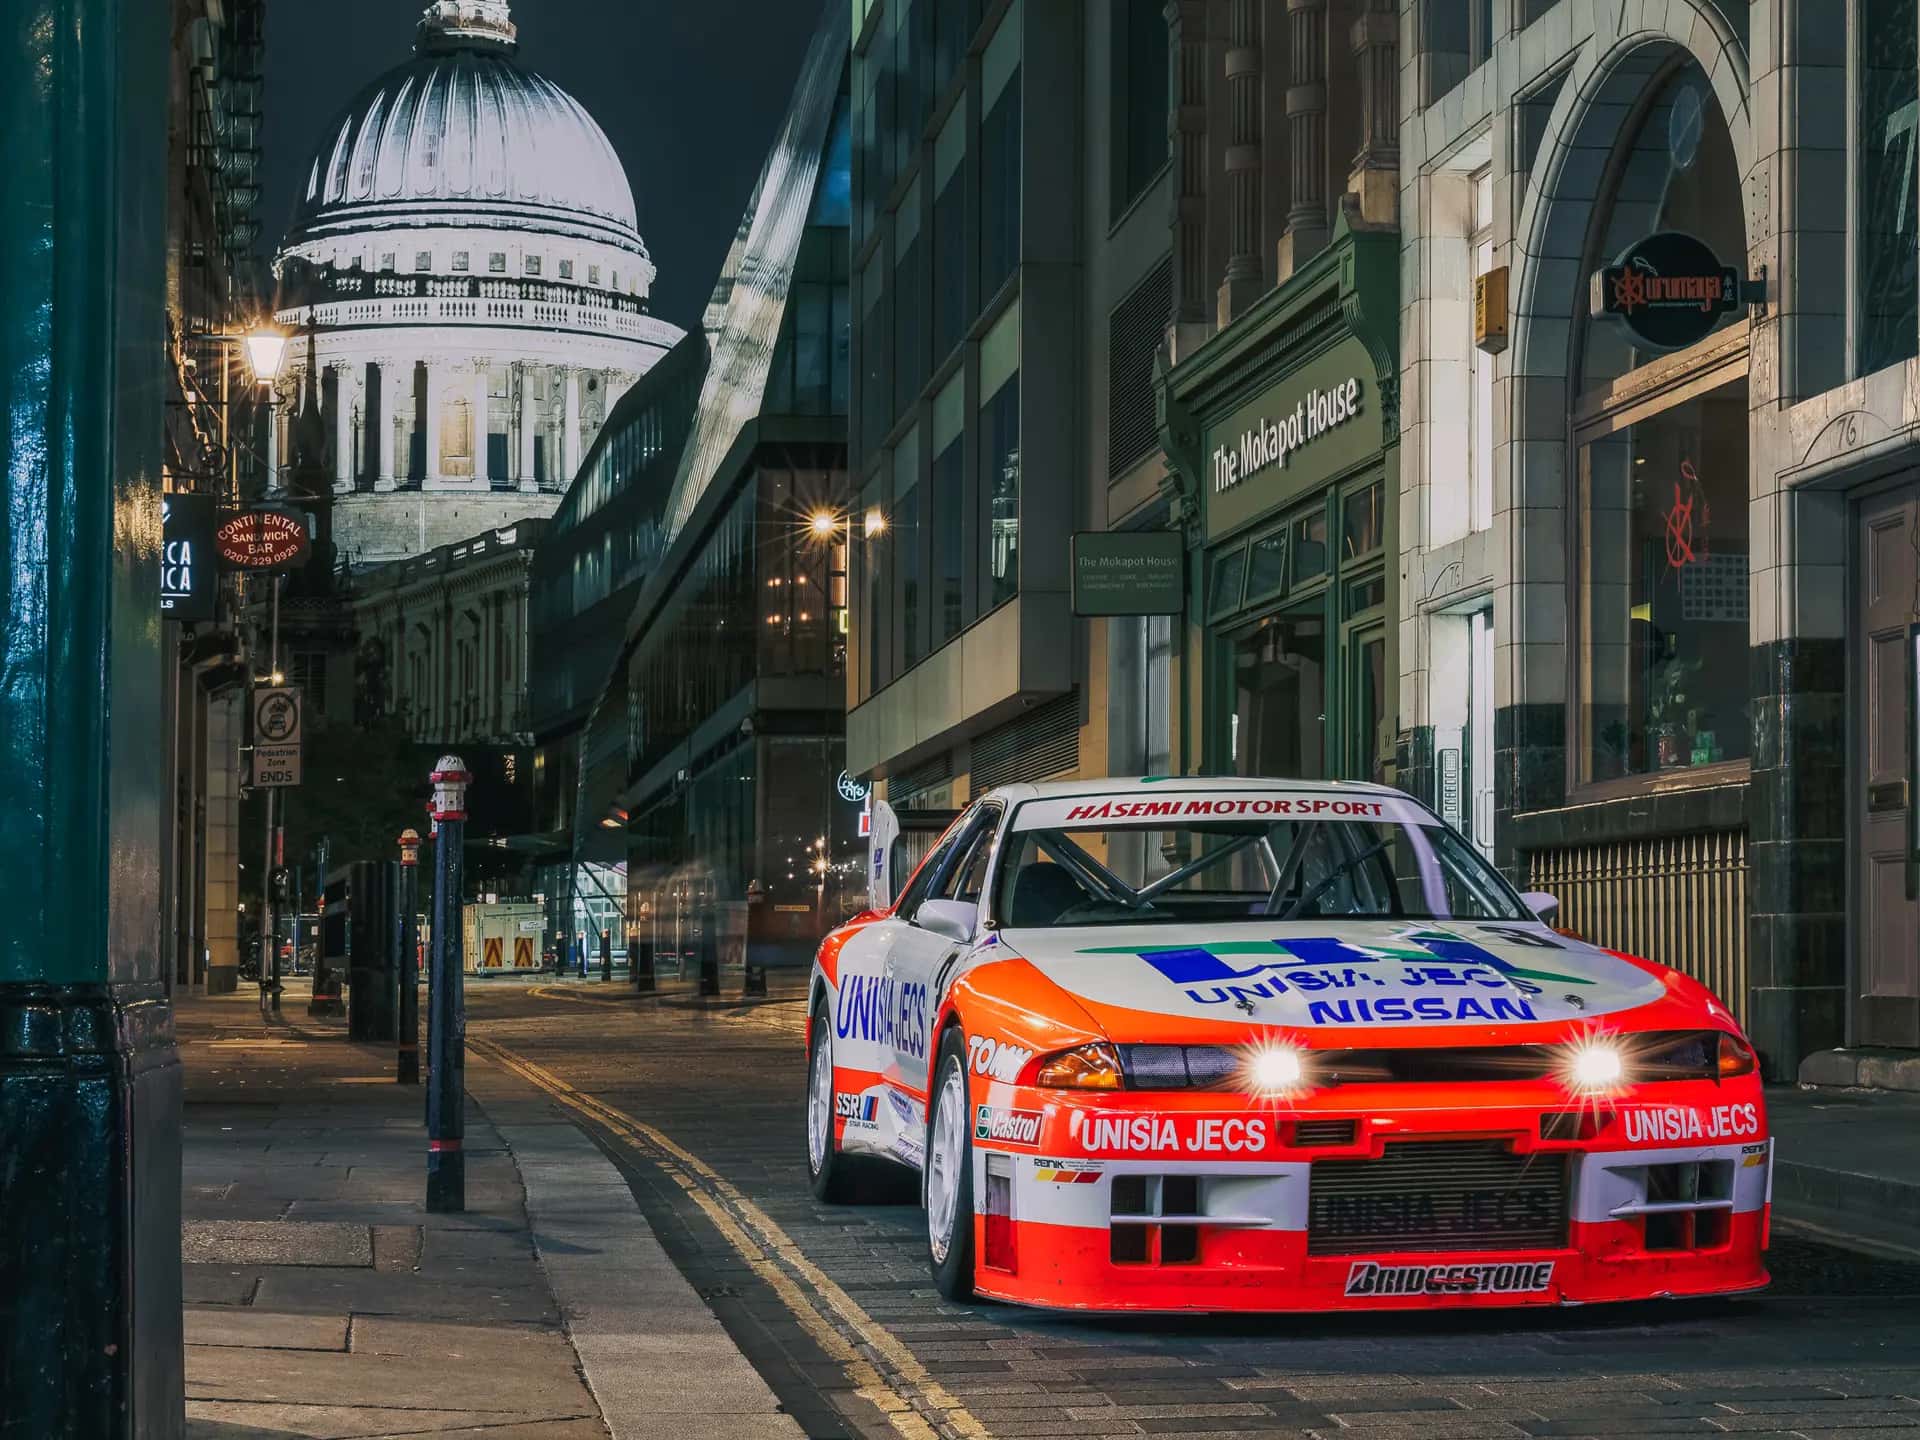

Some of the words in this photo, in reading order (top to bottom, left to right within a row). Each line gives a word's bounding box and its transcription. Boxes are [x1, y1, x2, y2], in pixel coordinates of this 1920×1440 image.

[1213, 444, 1238, 492] The
[1240, 400, 1304, 468] Mokapot
[1307, 378, 1357, 439] House
[1837, 415, 1857, 447] 76
[218, 513, 302, 540] CONTINENTAL
[232, 530, 289, 543] SANDWICH
[161, 541, 192, 566] CA
[224, 548, 249, 564] 0207
[252, 557, 272, 566] 329
[274, 544, 299, 562] 0929
[248, 543, 274, 554] BAR
[1079, 556, 1098, 567] The
[1099, 555, 1145, 568] Mokapot
[1147, 555, 1178, 567] House
[256, 749, 298, 757] Pedestrian
[267, 759, 286, 767] Zone
[260, 770, 293, 783] ENDS
[1066, 800, 1181, 821] HASEMI
[1400, 967, 1544, 995] JECS
[836, 974, 895, 1048] UNISIA
[895, 981, 926, 1059] JECS
[1308, 997, 1538, 1025] NISSAN
[837, 1091, 861, 1119] SSR
[991, 1112, 1041, 1142] Castrol
[1081, 1118, 1180, 1152] UNISIA
[1186, 1118, 1266, 1152] JECS
[1624, 1107, 1703, 1143] UNISIA
[1707, 1103, 1759, 1138] JECS
[1344, 1261, 1555, 1297] BRIDGESTONE
